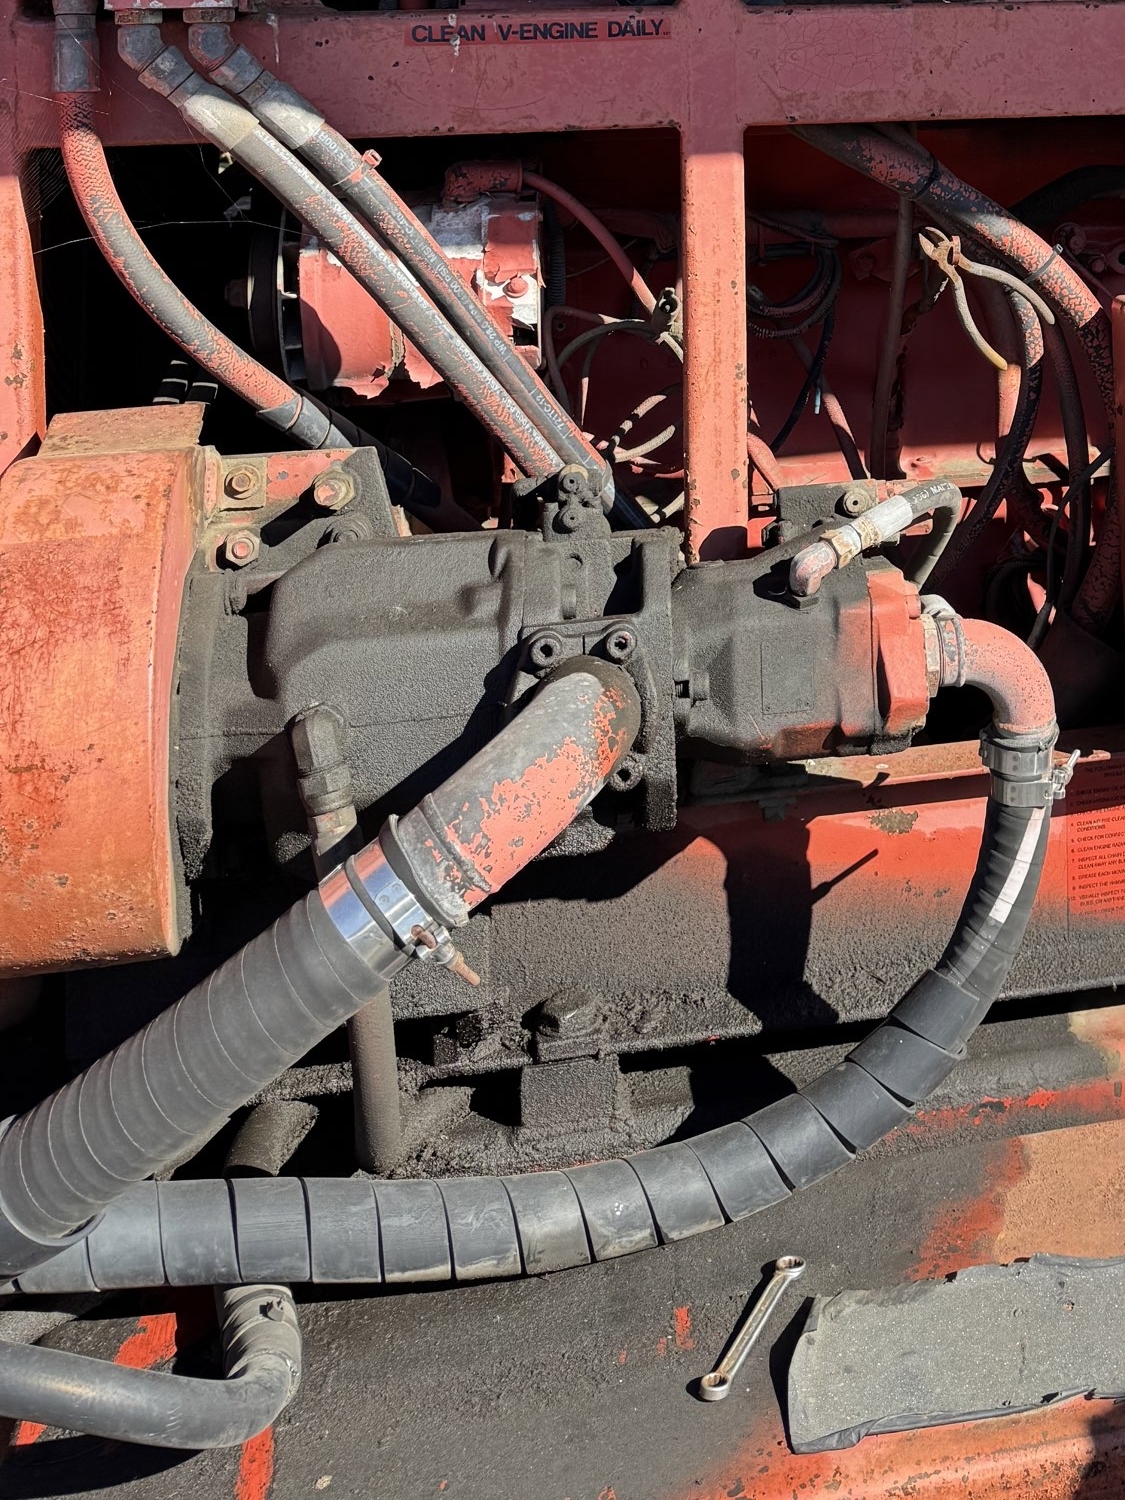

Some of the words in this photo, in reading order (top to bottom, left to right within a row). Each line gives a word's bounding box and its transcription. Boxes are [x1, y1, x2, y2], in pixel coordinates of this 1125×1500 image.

[411, 24, 486, 43] CLEAN
[496, 21, 599, 41] V-ENGINE
[490, 336, 510, 356] WP
[531, 390, 569, 431] 721TC-12
